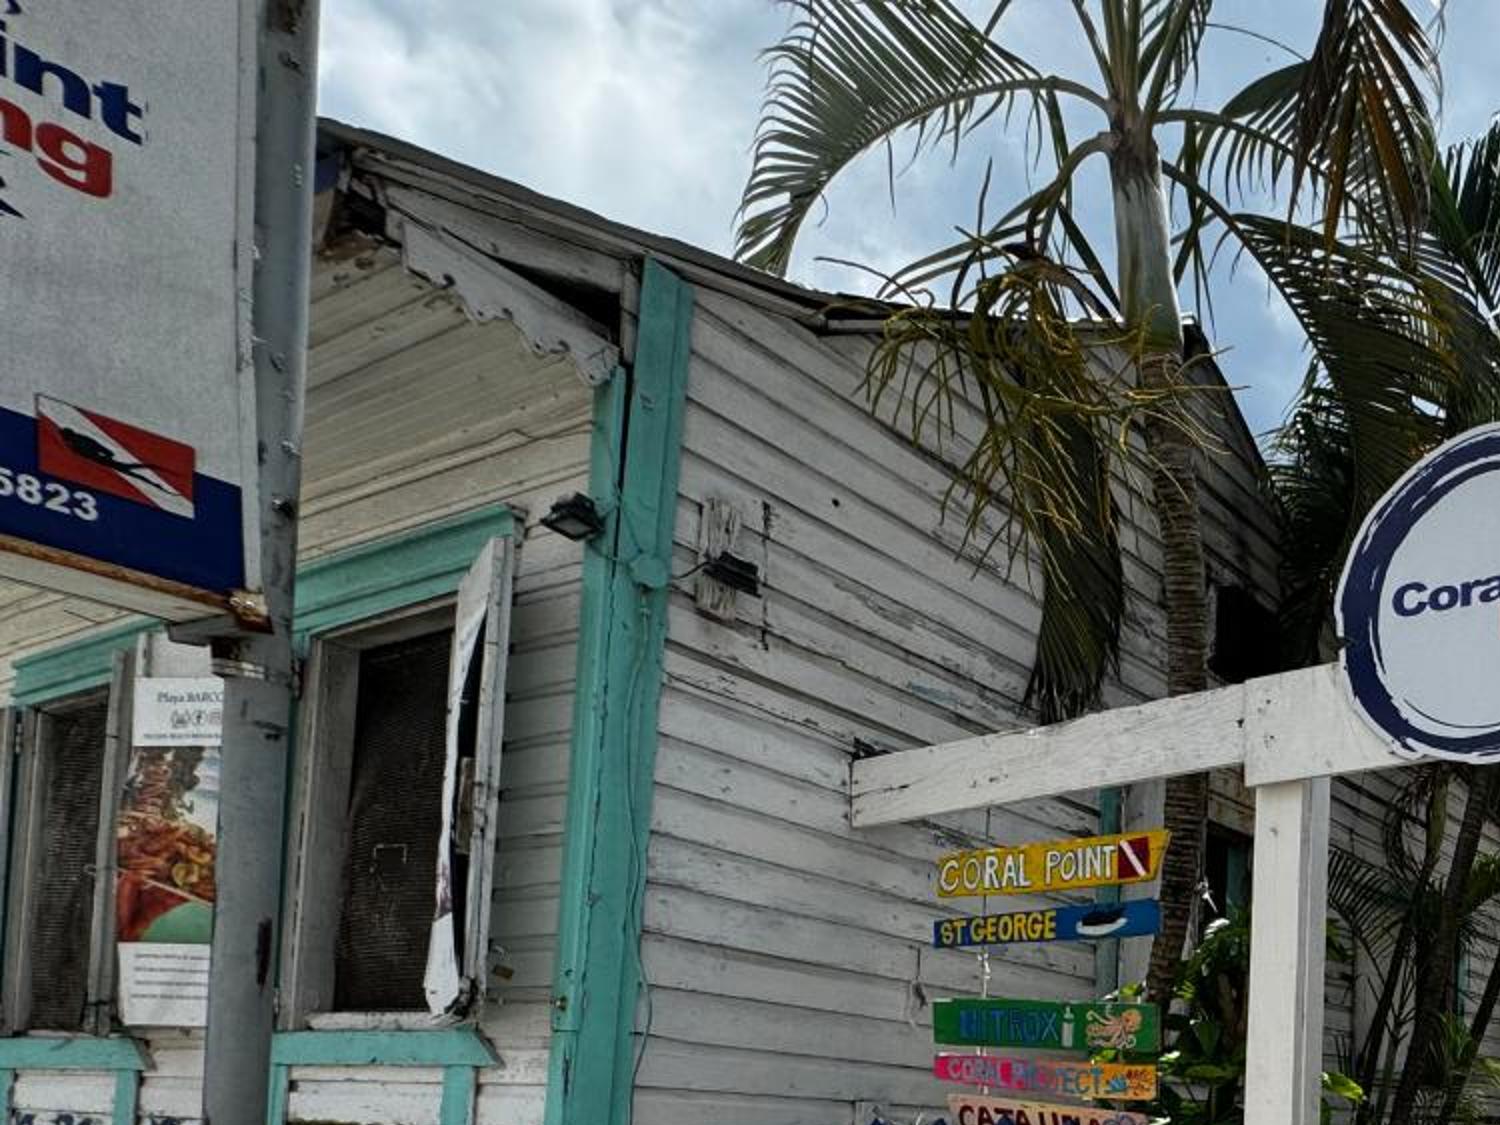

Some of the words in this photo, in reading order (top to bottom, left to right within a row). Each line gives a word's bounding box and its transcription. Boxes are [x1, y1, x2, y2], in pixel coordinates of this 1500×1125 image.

[0, 20, 142, 146] nt
[939, 853, 1032, 892] CORAL
[1045, 844, 1117, 885] POINT
[940, 919, 967, 945] ST
[969, 910, 1056, 943] GEORGE
[946, 1057, 1011, 1088] CORAL
